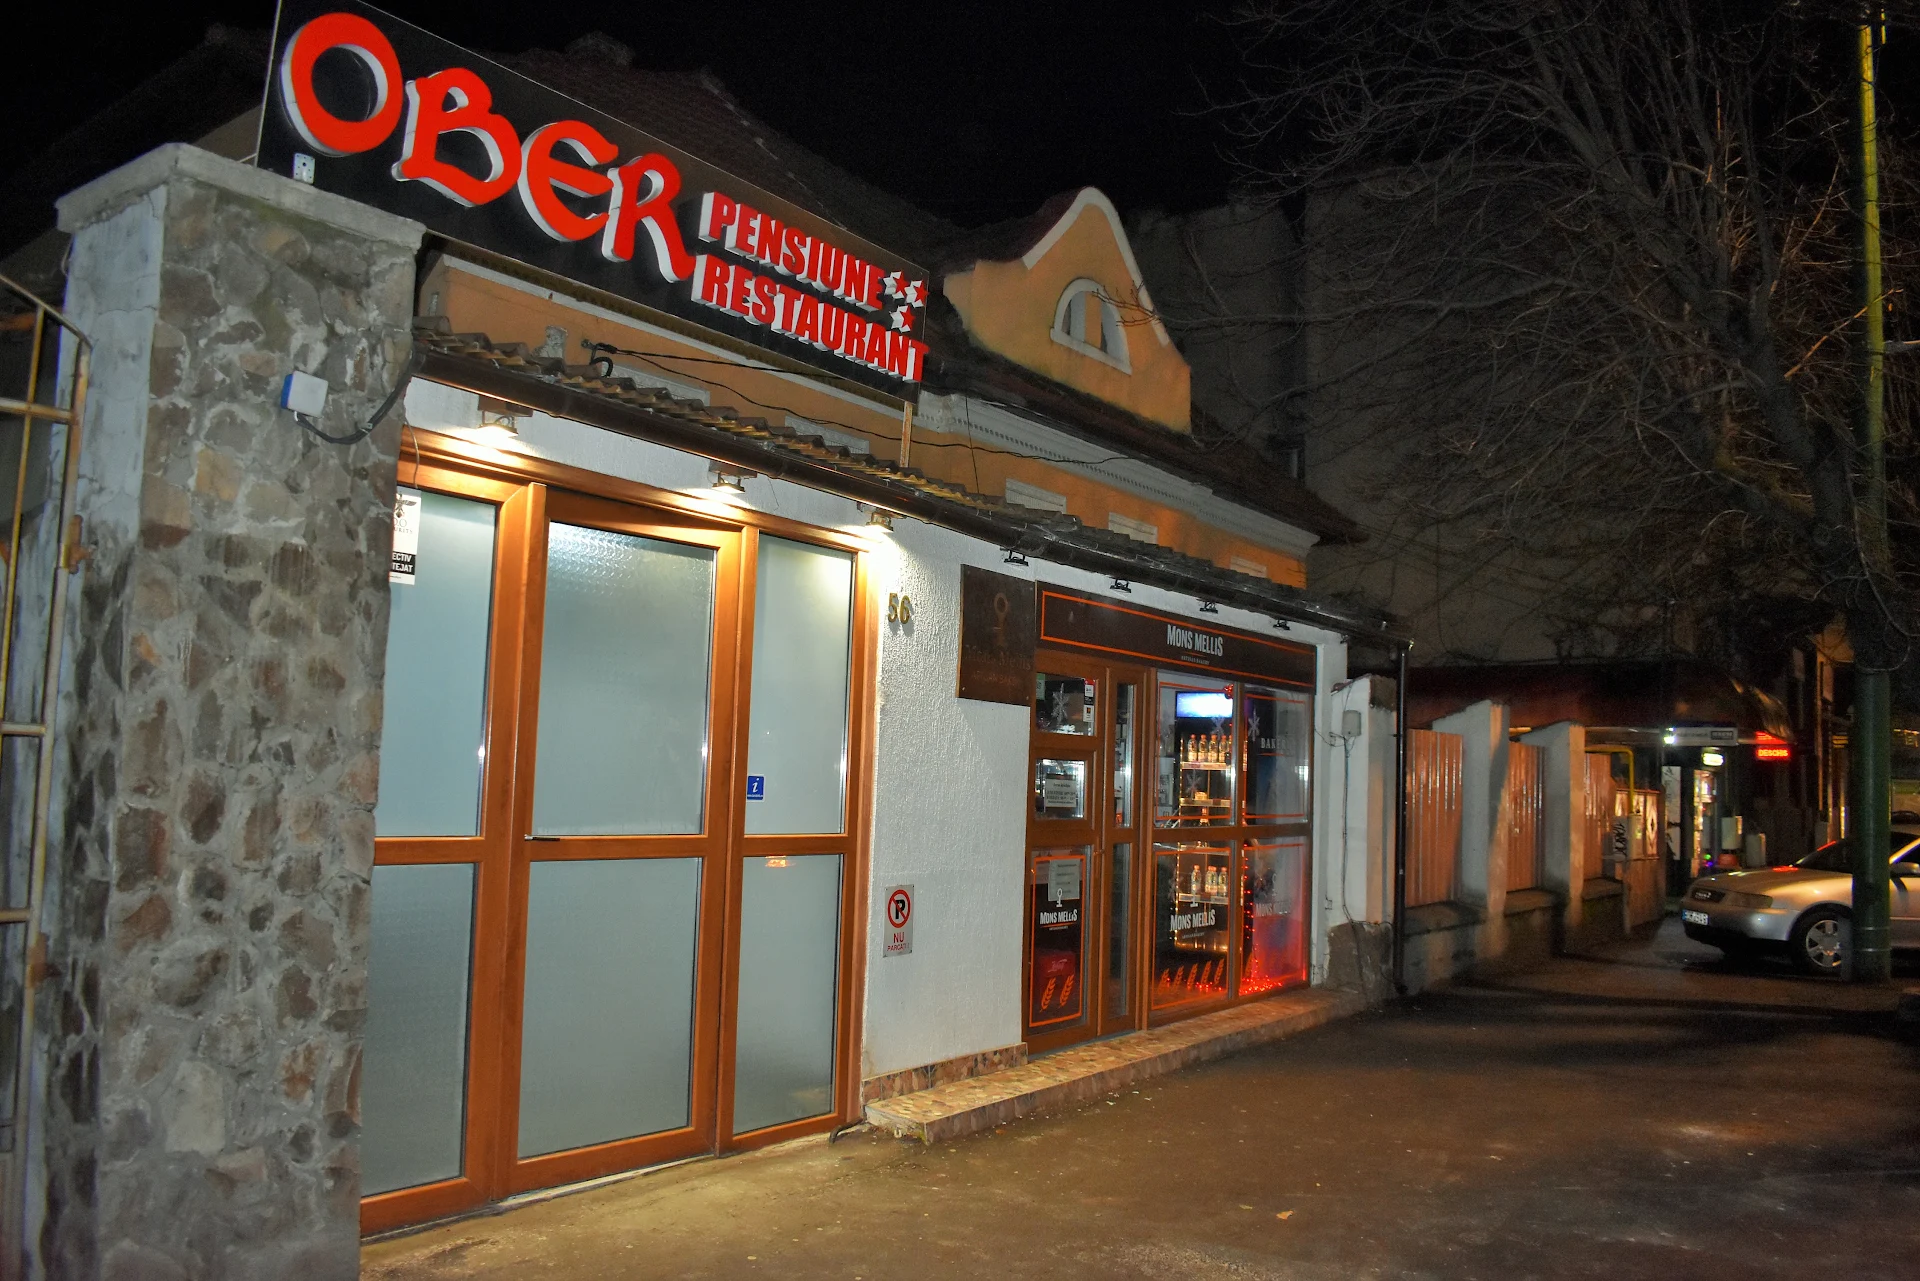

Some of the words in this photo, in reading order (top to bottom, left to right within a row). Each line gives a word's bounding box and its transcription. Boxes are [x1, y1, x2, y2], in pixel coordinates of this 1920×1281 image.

[281, 12, 696, 283] OBER
[699, 192, 885, 311] PENSIUNE
[692, 254, 929, 382] RESTAURANT
[392, 553, 412, 562] ECTIV
[392, 562, 413, 572] TEJAT
[888, 593, 910, 624] 56
[1167, 624, 1193, 650] MONS
[1194, 632, 1223, 657] MELLIS
[1758, 749, 1788, 757] DESCHIS
[1040, 912, 1058, 925] MONS
[1058, 909, 1078, 923] MELLIS
[1170, 914, 1192, 932] MONS
[1192, 909, 1216, 928] MELLIS
[893, 932, 905, 943] NU
